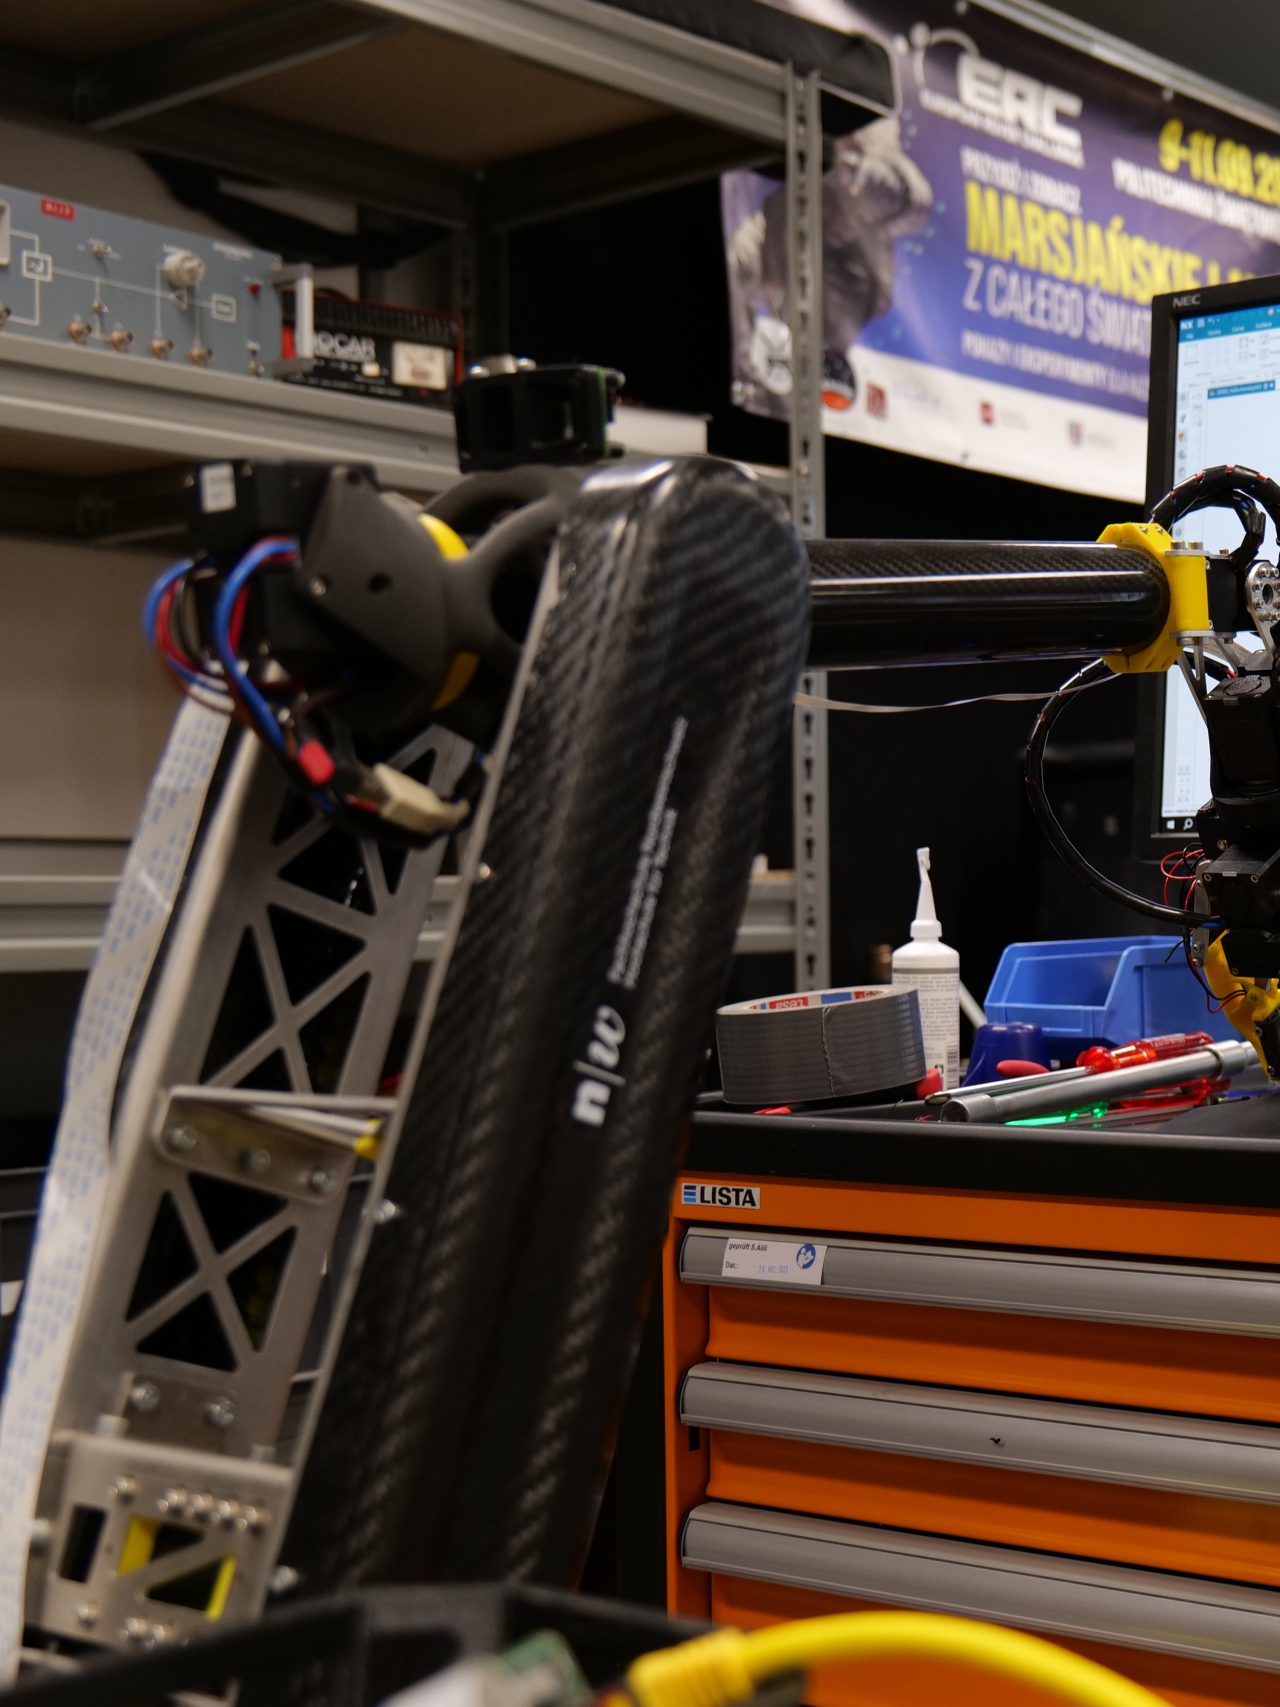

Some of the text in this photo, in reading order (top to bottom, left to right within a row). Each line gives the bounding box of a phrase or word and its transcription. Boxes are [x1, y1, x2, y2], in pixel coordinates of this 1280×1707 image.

[957, 53, 1083, 149] ERC
[962, 256, 985, 313] Z
[986, 264, 1085, 340] CAŁEGO
[1173, 294, 1202, 308] NEC
[1180, 320, 1194, 331] NX
[775, 998, 804, 1010] tesa
[700, 1185, 757, 1207] LISTA
